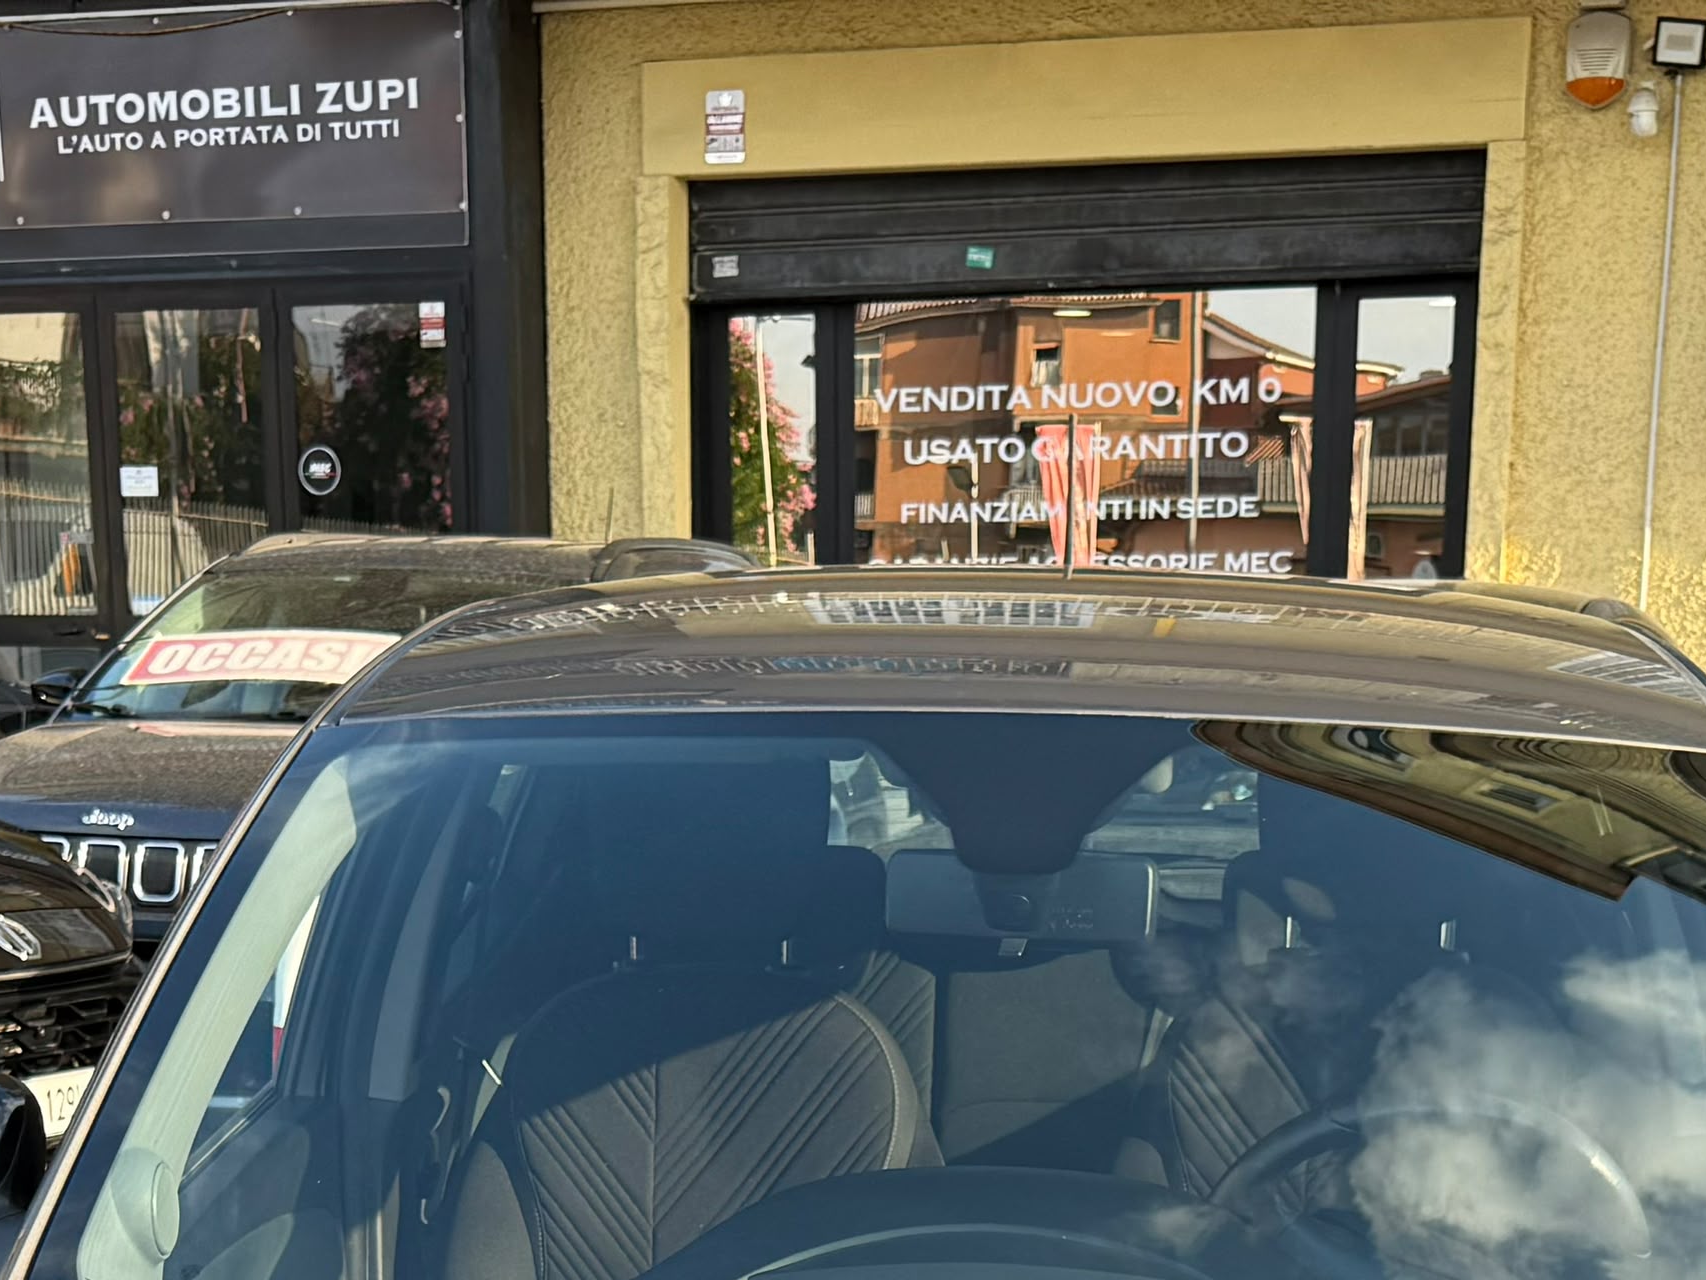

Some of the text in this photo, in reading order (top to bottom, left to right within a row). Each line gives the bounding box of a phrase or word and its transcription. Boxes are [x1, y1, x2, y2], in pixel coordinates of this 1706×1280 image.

[29, 77, 419, 129] AUTOMOBILI ZUPI
[57, 119, 400, 155] L'AUTO A PORTATA DI TUTTI
[873, 383, 1032, 413] VENDITA
[1041, 380, 1183, 411] NUOVO,
[1195, 377, 1250, 406] KM
[903, 436, 1027, 466] USATO
[900, 496, 1260, 525] FINANZIAMNTI IN SEDE
[1225, 551, 1295, 574] MEC
